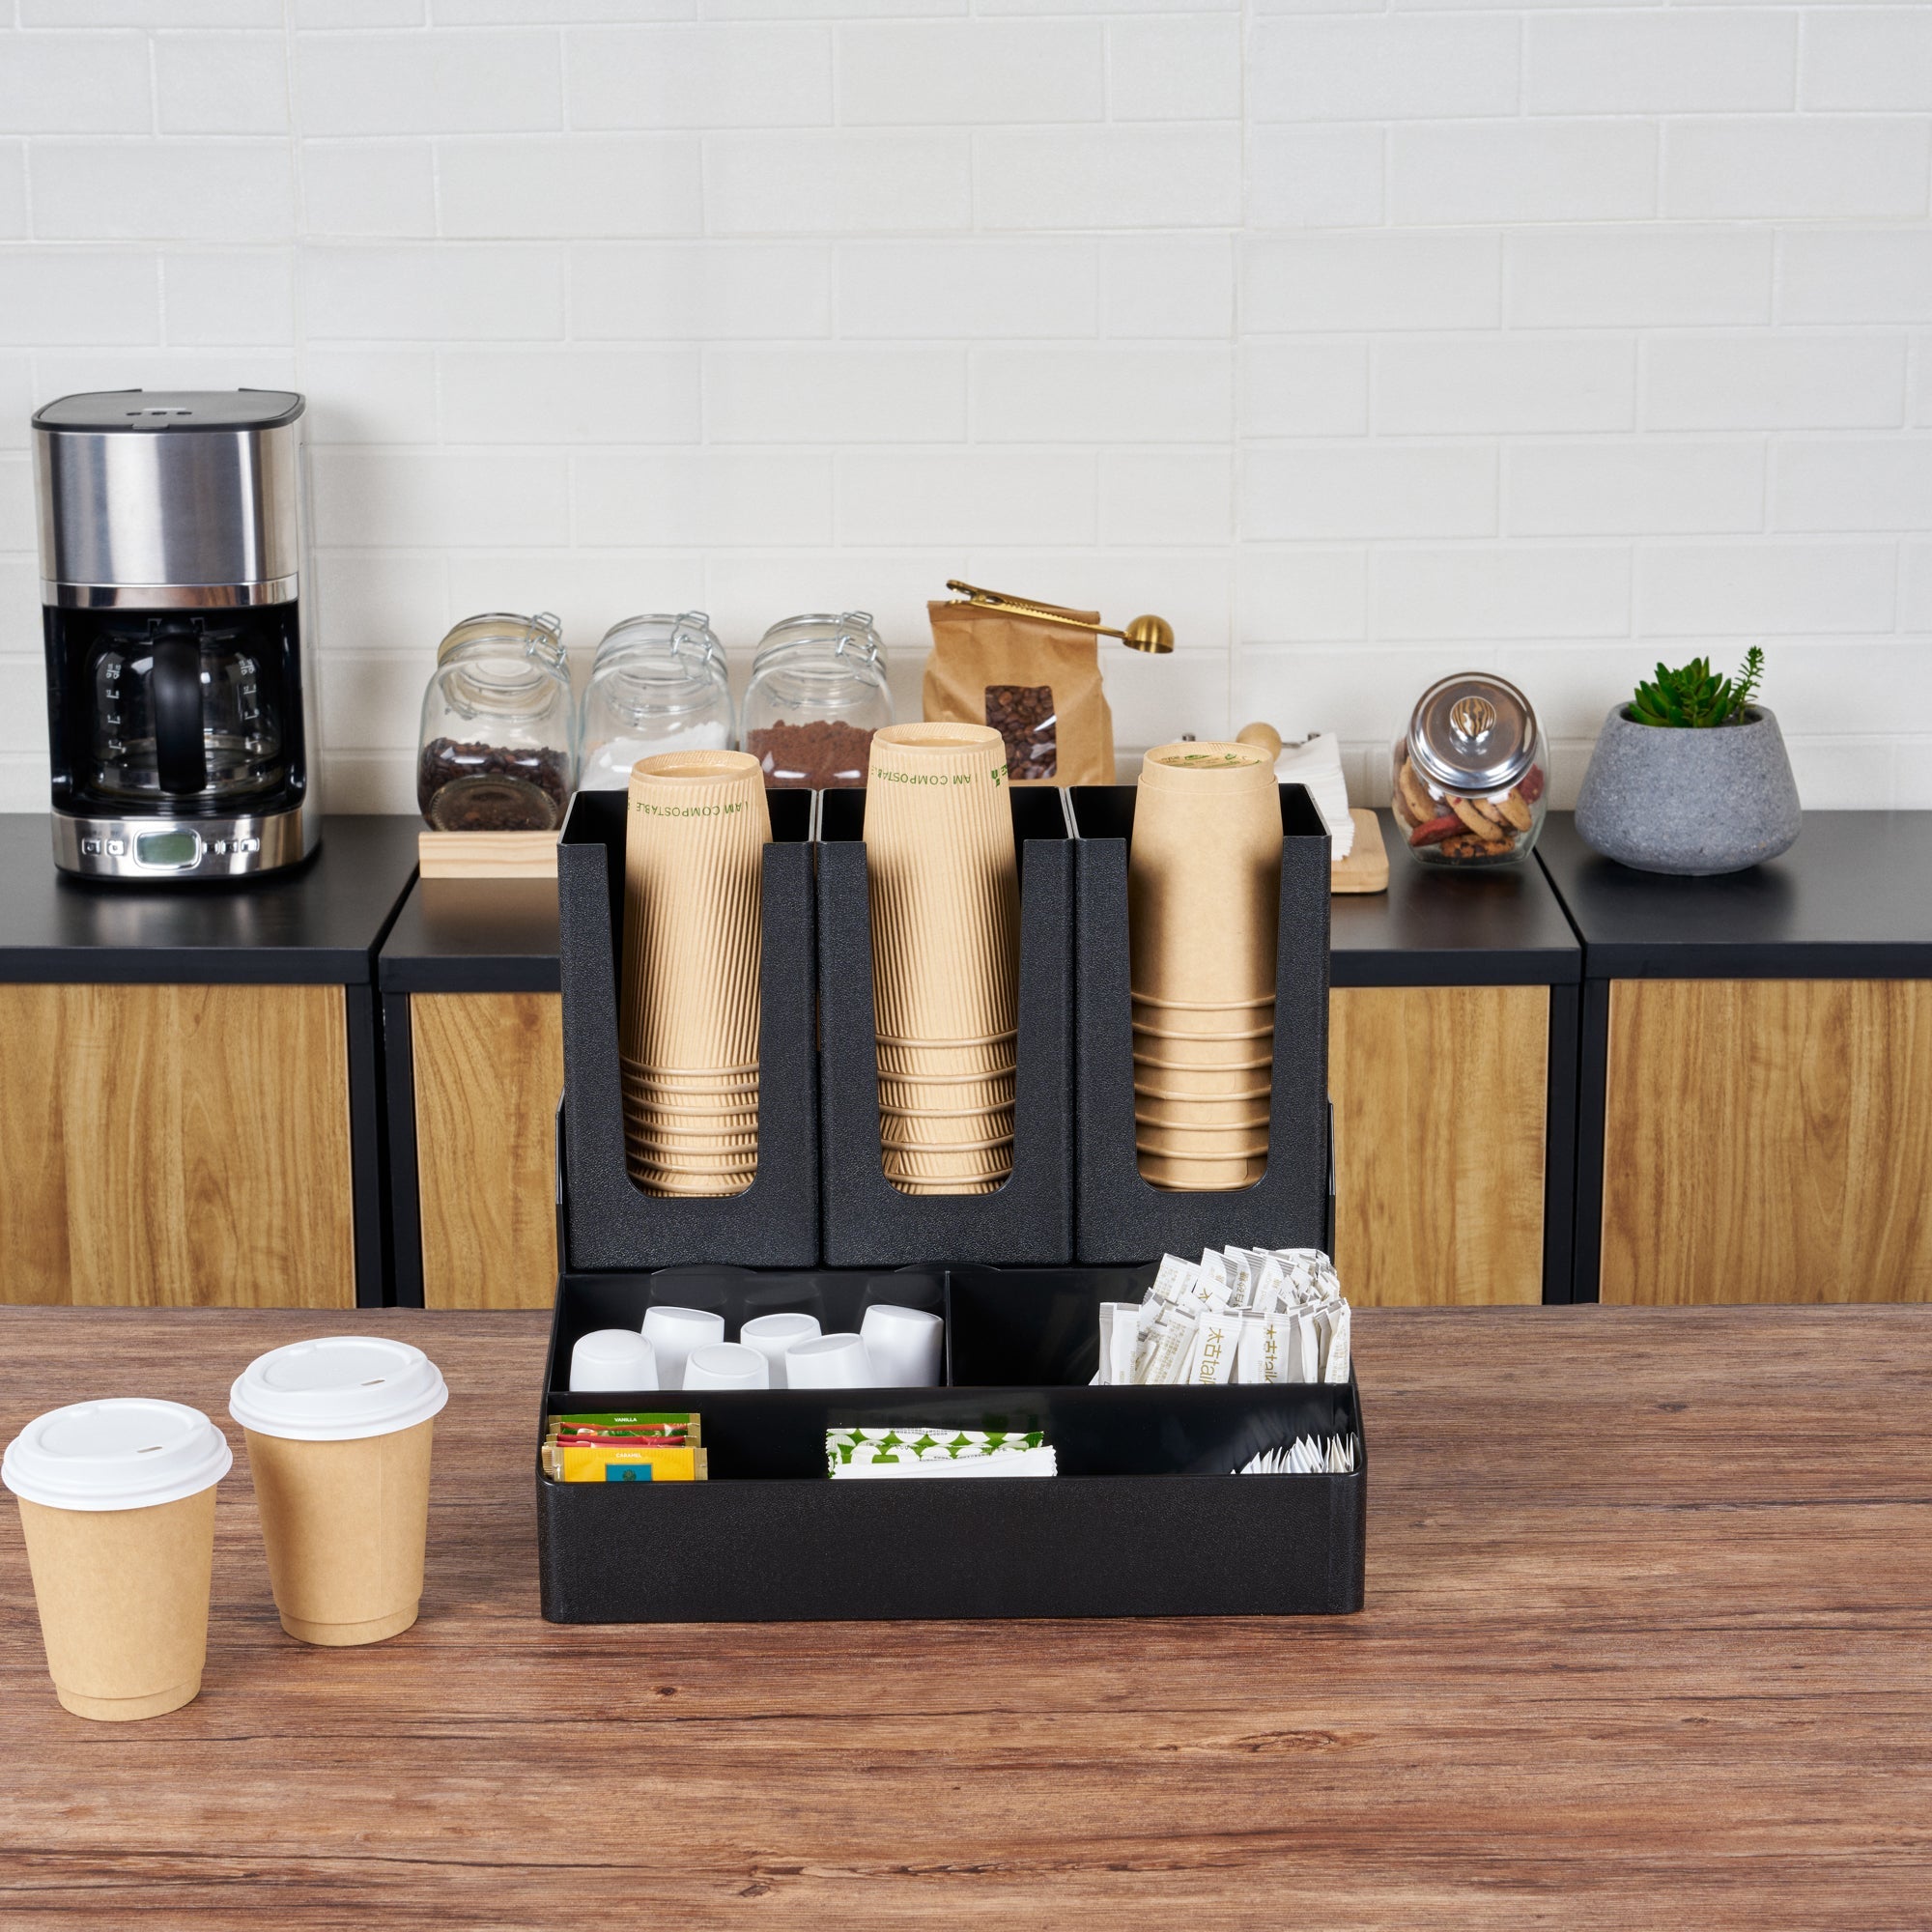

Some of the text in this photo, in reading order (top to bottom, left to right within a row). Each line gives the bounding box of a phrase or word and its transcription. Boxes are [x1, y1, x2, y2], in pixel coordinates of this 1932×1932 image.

[952, 774, 972, 784] AM
[636, 802, 721, 817] COMPOSTABLE
[724, 802, 743, 814] AM
